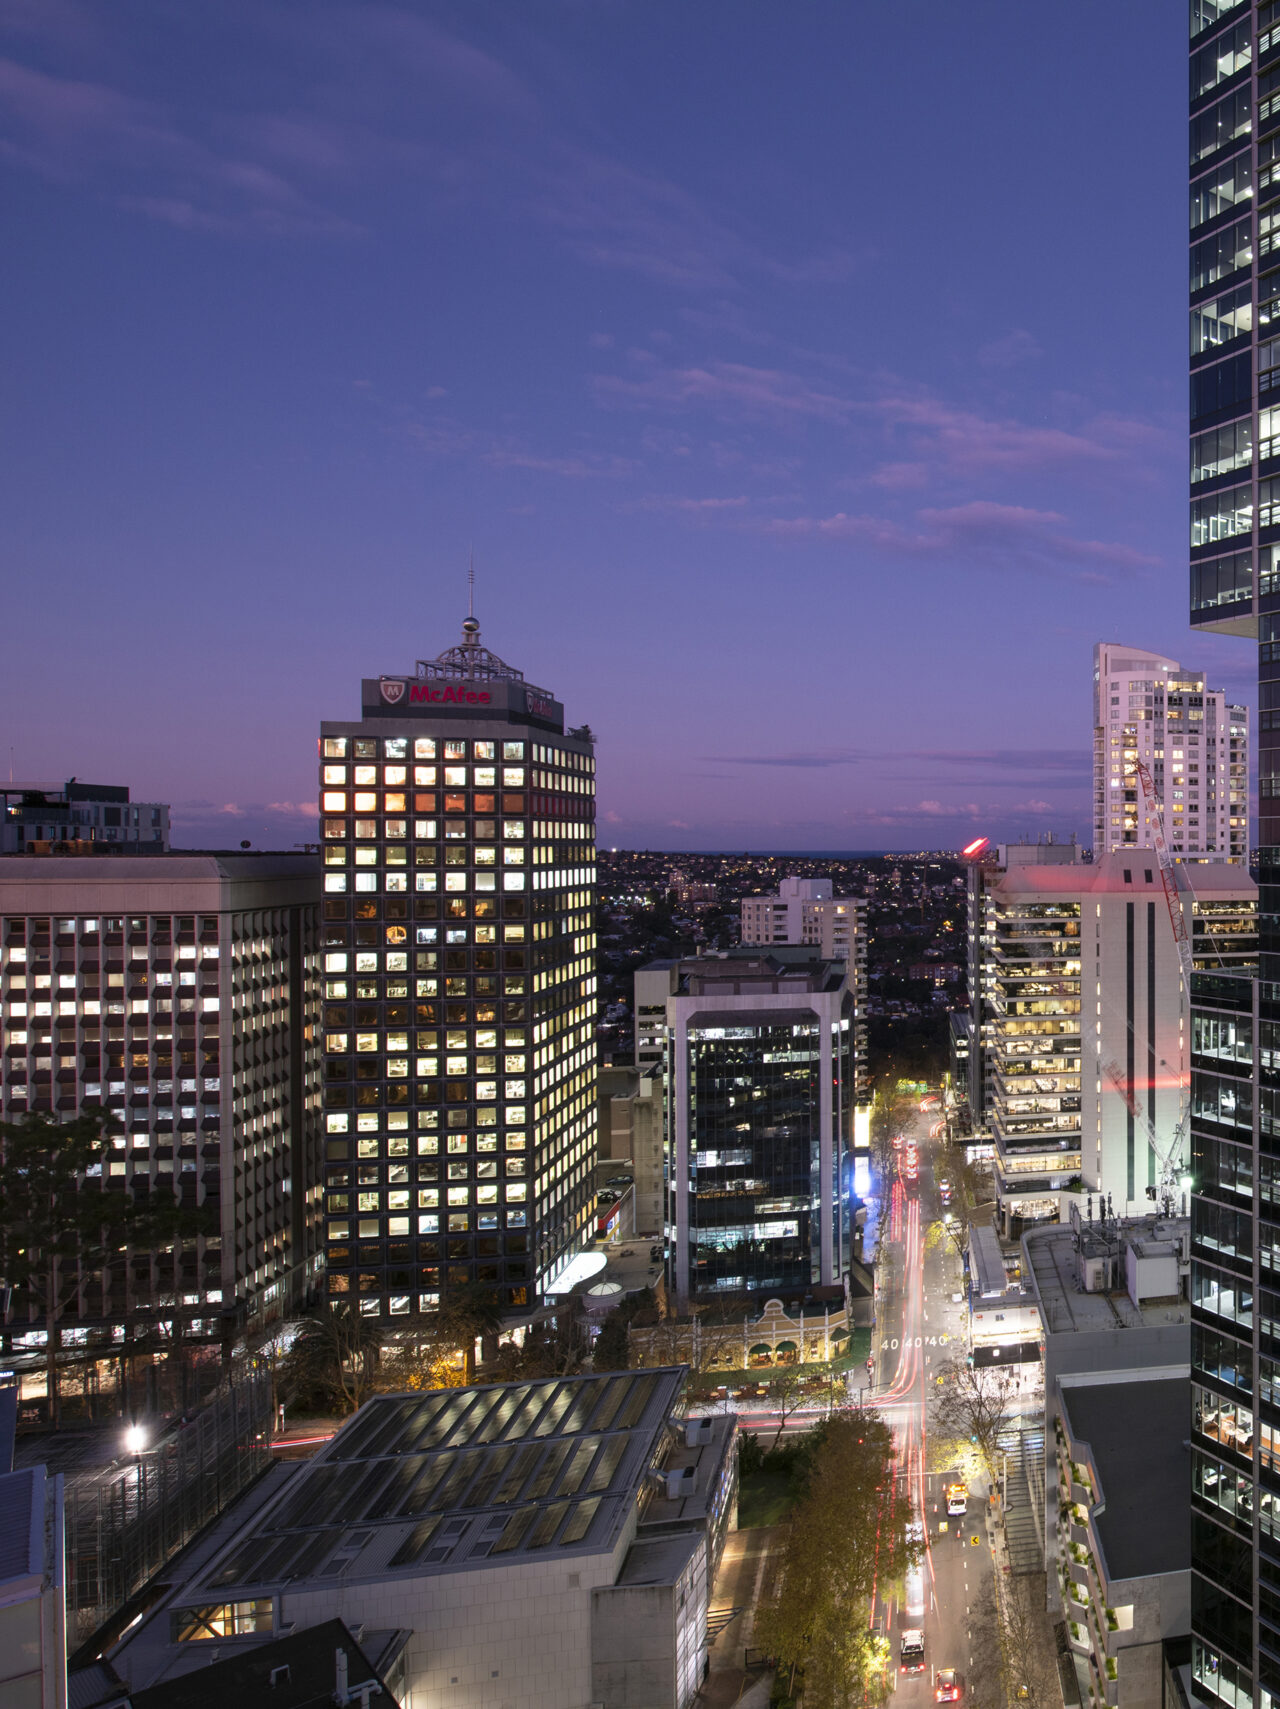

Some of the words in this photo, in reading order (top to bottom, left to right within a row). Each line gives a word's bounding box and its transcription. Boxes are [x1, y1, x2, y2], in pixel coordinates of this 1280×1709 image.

[386, 685, 399, 696] M
[409, 685, 491, 704] McAfee
[881, 1338, 899, 1350] 40
[905, 1337, 922, 1348] 40
[929, 1335, 946, 1347] 40
